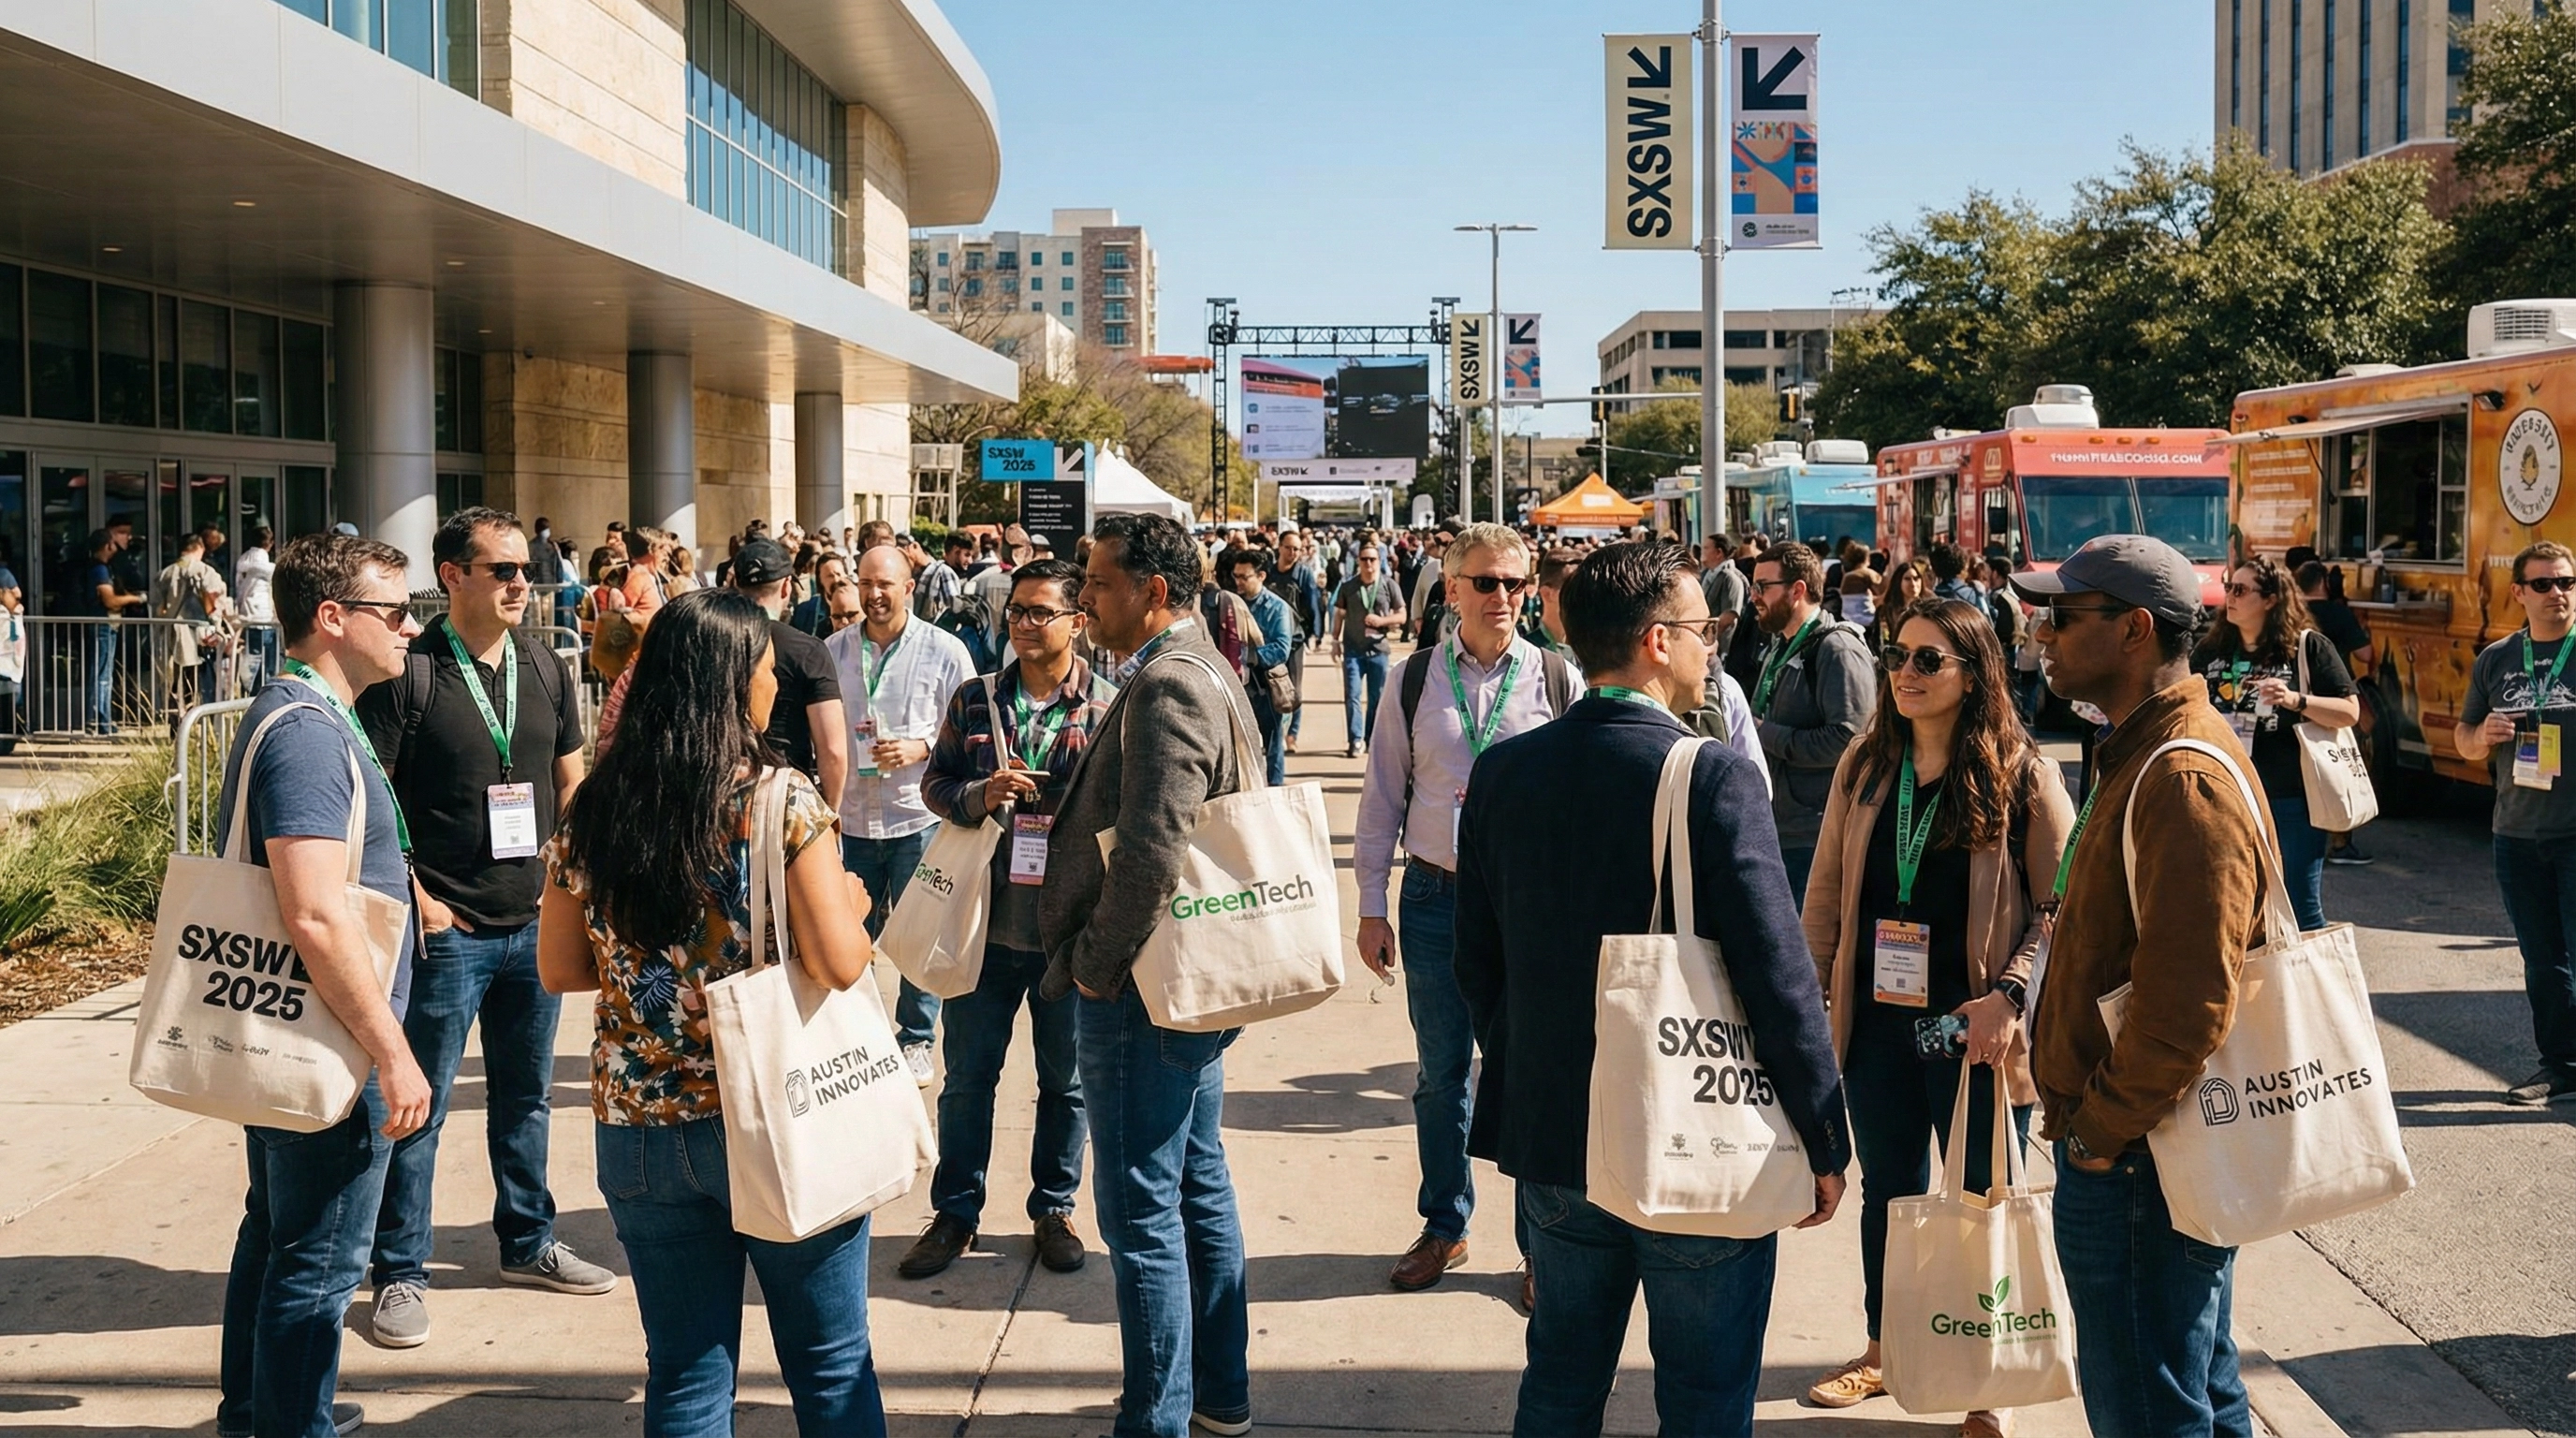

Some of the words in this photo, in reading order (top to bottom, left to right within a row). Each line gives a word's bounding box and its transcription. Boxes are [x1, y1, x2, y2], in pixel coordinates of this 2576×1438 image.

[1627, 96, 1672, 238] SXSW
[1460, 340, 1480, 400] SXSW
[988, 448, 1024, 459] SXSW
[1003, 460, 1036, 471] 2025
[1170, 874, 1313, 919] GreenTech
[178, 924, 292, 976] SXSW
[202, 970, 307, 1021] 2025
[811, 1046, 870, 1085] AUSTIN
[814, 1054, 900, 1107] INNOVATES
[1693, 1064, 1774, 1107] 2025
[2245, 1058, 2323, 1095] AUSTIN
[2248, 1067, 2373, 1119] INNOVATES
[1930, 1308, 2056, 1338] GreenTech
